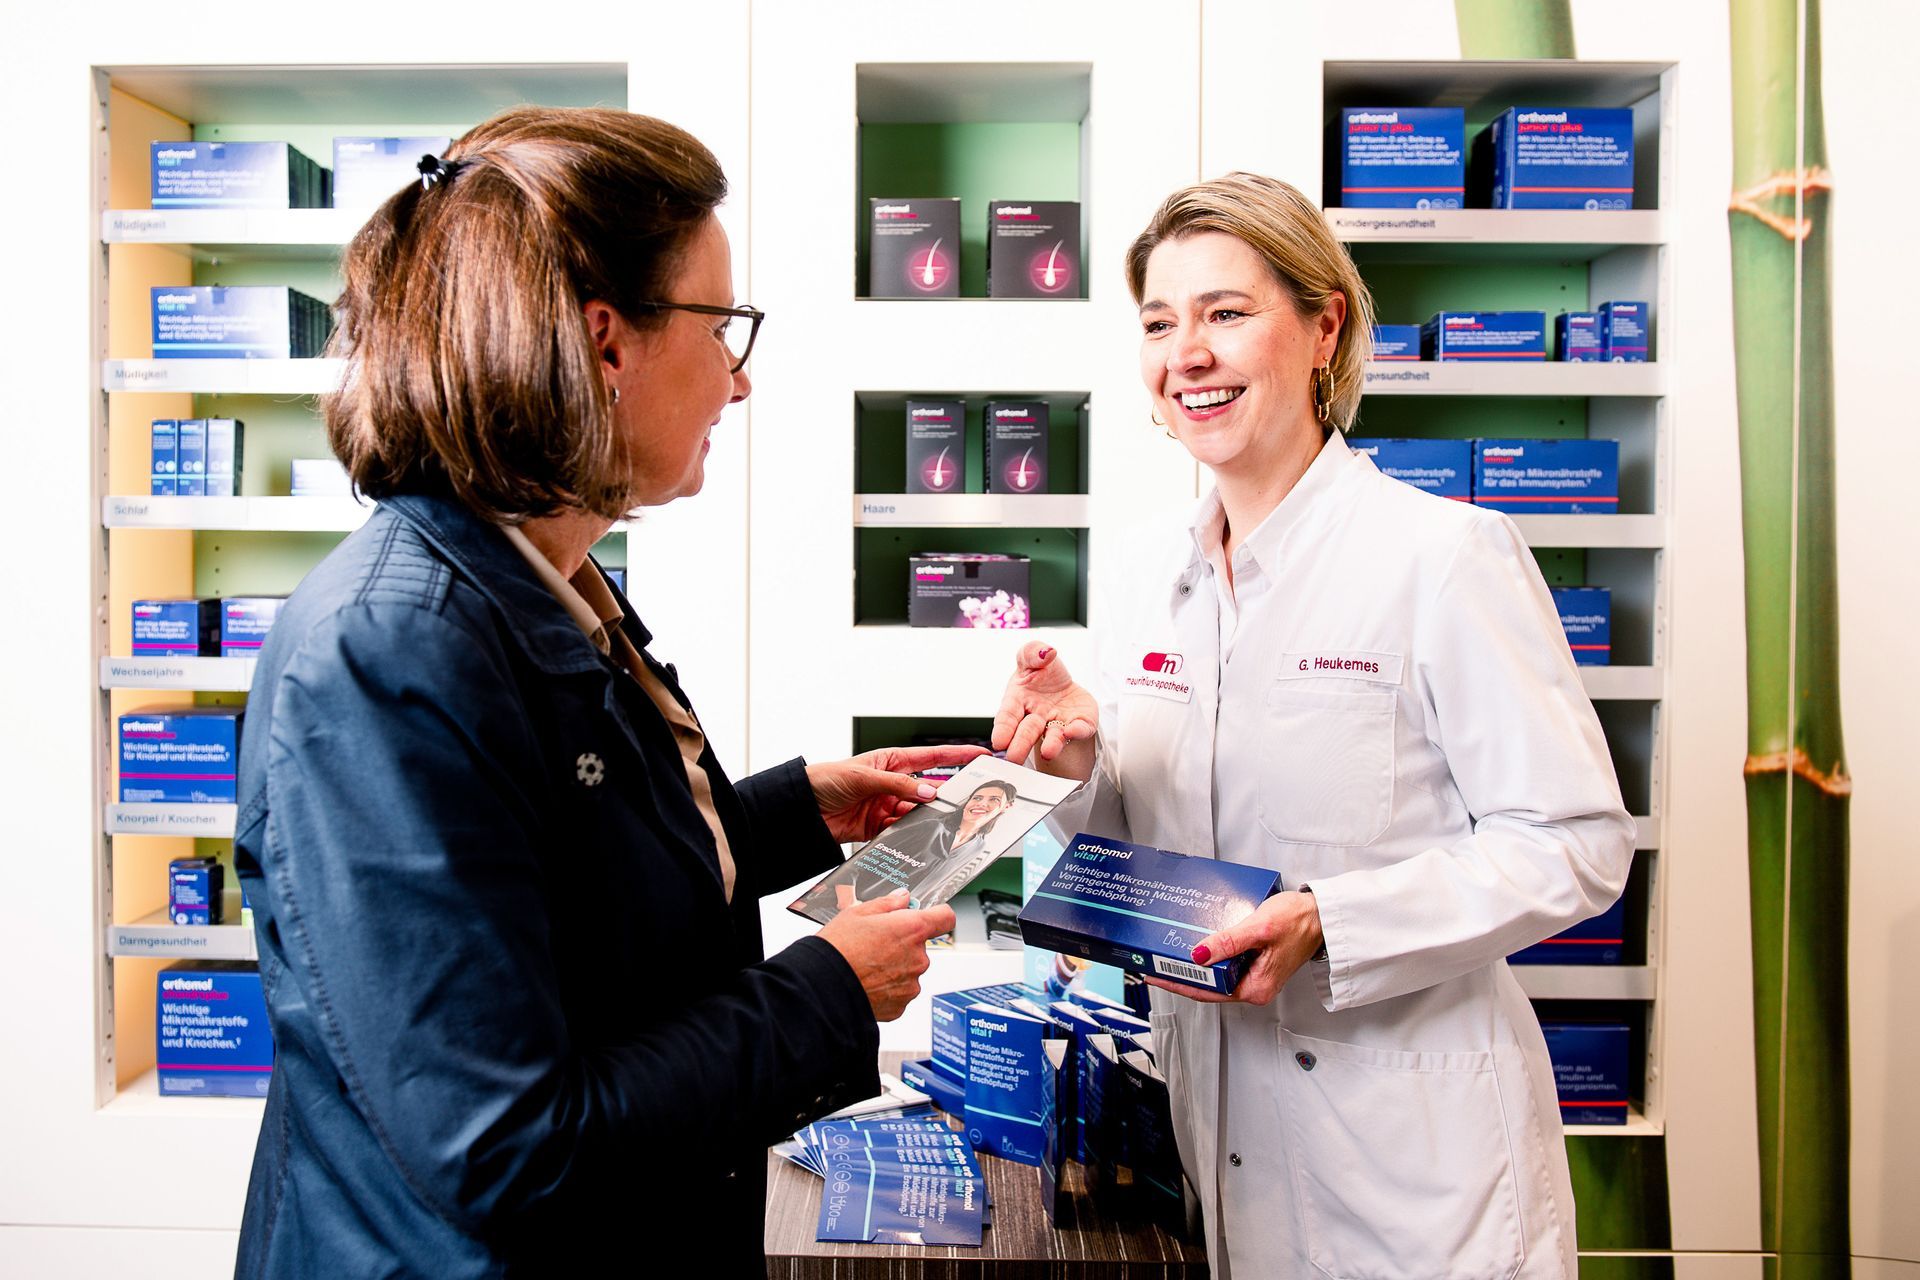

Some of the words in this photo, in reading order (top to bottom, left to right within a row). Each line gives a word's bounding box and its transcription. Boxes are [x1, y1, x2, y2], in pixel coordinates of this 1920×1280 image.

[1348, 112, 1398, 124] orthomol
[1517, 112, 1567, 123] orthomol
[113, 220, 167, 234] Müdigkeit
[1365, 371, 1430, 382] gesundheit
[1483, 468, 1525, 479] Wichtige
[114, 503, 148, 516] Schlaf
[863, 503, 895, 515] Haare
[1560, 614, 1606, 625] nährstoffe
[1298, 659, 1310, 671] G.
[1314, 657, 1379, 673] Heukemes
[111, 667, 184, 681] Wechseljahre
[116, 815, 159, 827] Knorpel
[169, 815, 217, 826] Knochen
[874, 842, 927, 868] Erschöpfung?
[881, 852, 900, 866] mich
[1073, 850, 1099, 866] vital
[1077, 842, 1134, 862] orthomol
[1051, 880, 1072, 894] und
[1064, 862, 1111, 883] Wichtige
[1111, 872, 1204, 901] Mikronährstoffe
[1204, 892, 1226, 906] zur
[1057, 871, 1129, 896] Verringerung
[1129, 885, 1152, 900] von
[1152, 890, 1212, 913] Müdigkeit
[119, 935, 208, 948] Darmgesundheit
[162, 977, 213, 991] orthomol
[162, 1003, 210, 1016] Wichtige
[162, 1015, 249, 1027] Mikronährstoffe
[970, 1018, 1008, 1033] orthomol
[162, 1026, 179, 1037] für
[180, 1026, 223, 1038] Knorpel
[970, 1027, 988, 1038] vital
[1100, 1025, 1131, 1039] rthomol
[162, 1037, 184, 1048] und
[970, 1039, 1001, 1054] Wichtige
[1001, 1047, 1025, 1058] Mikro-
[970, 1049, 1005, 1063] nährstoffe
[1005, 1058, 1018, 1067] zur
[970, 1057, 1015, 1075] Verringerung
[1015, 1068, 1030, 1077] von
[970, 1066, 1004, 1081] Müdigkeit
[1004, 1074, 1020, 1083] und
[1586, 1073, 1604, 1082] und
[954, 1179, 964, 1193] vital
[963, 1179, 975, 1211] orthomol
[909, 1203, 918, 1218] und
[917, 1215, 927, 1228] von
